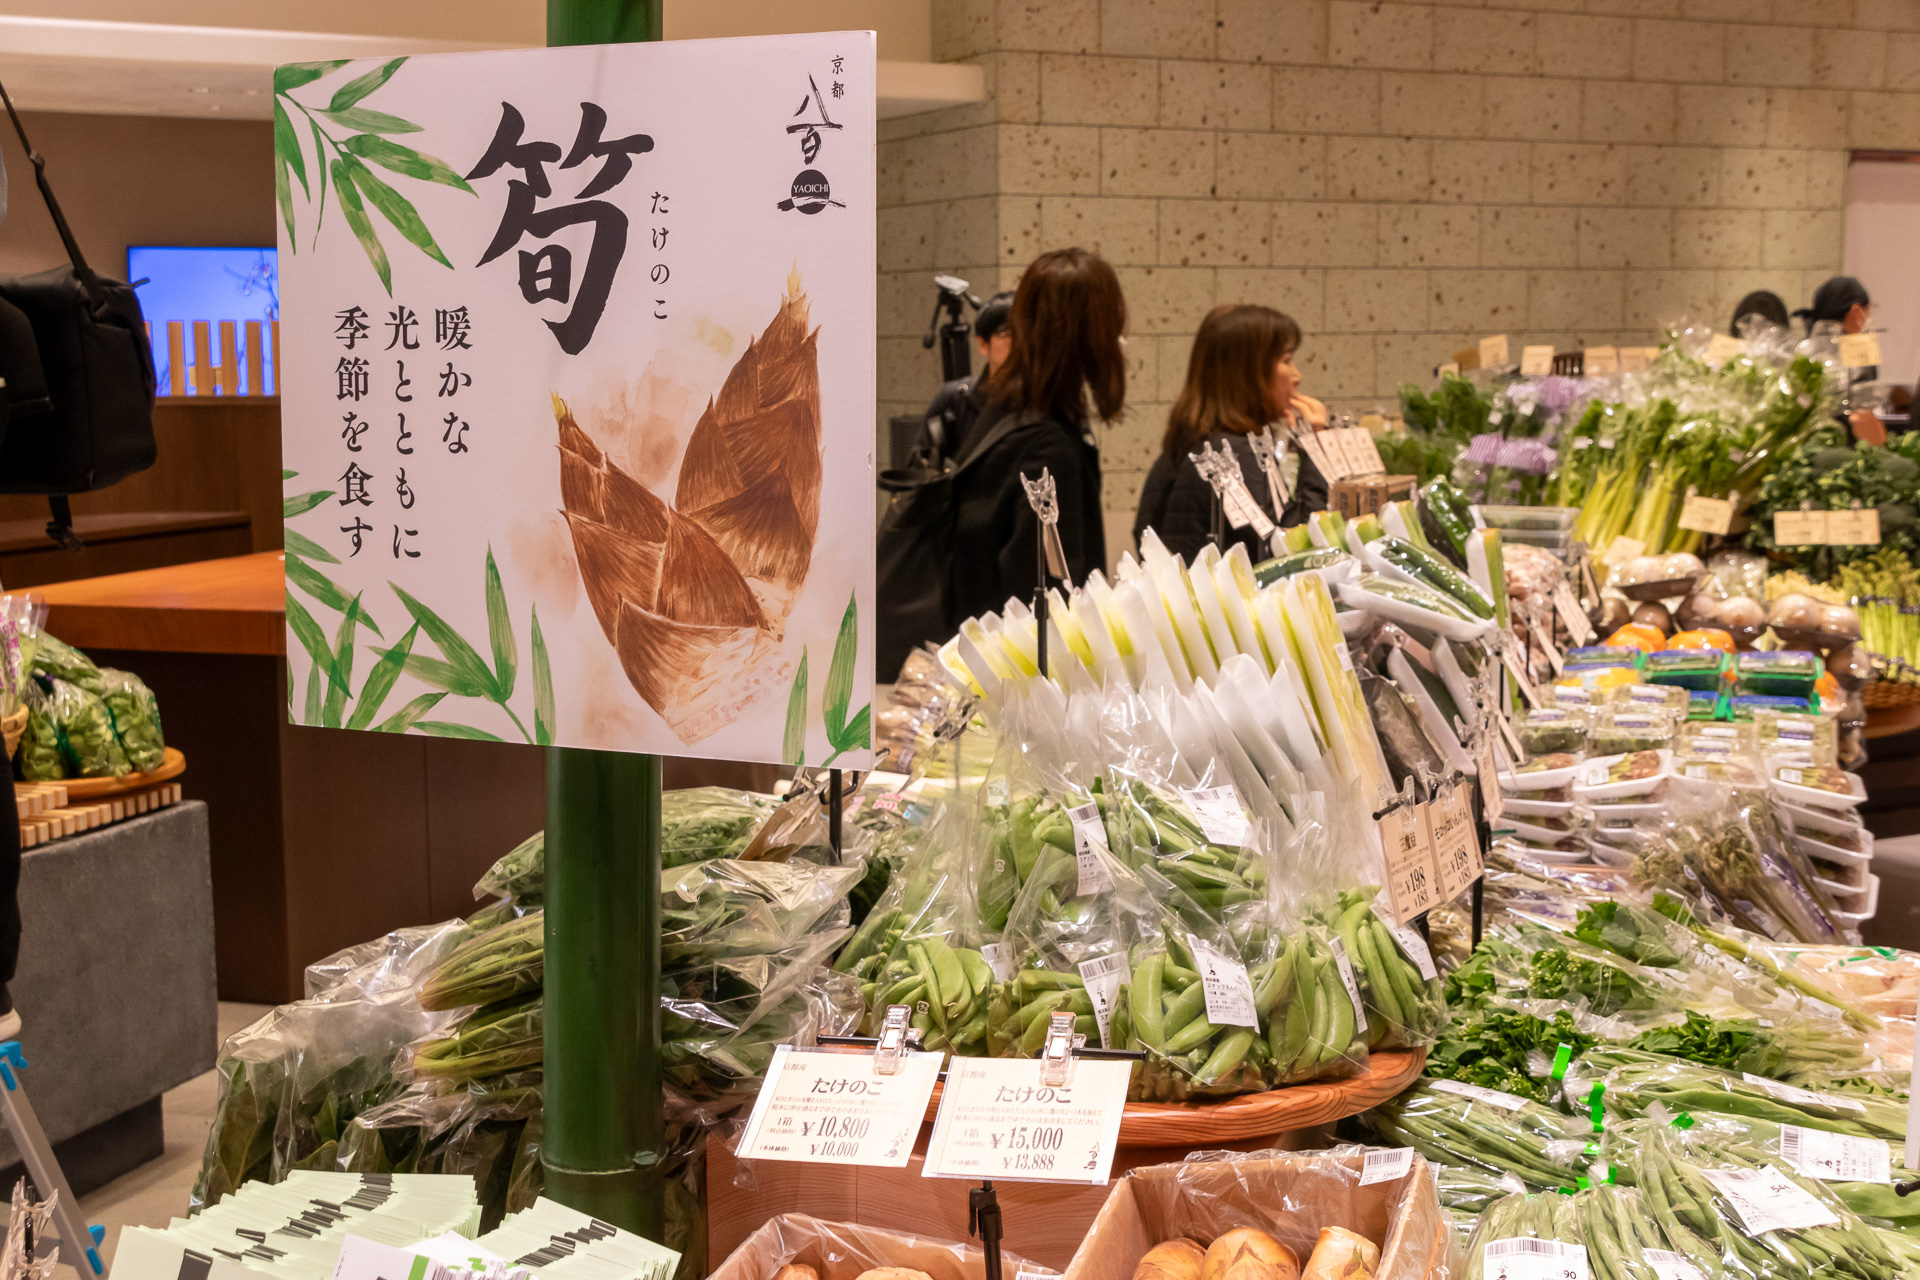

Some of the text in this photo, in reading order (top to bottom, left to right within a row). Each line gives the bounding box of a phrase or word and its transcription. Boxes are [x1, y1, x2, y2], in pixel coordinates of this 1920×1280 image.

[831, 55, 844, 99] 京都
[793, 184, 828, 193] YAOICHI
[465, 102, 655, 355] 筍
[651, 191, 669, 320] たけのこ
[435, 305, 472, 454] 暖かな
[334, 305, 374, 558] 季節を食す
[384, 304, 421, 559] 光とともに
[811, 1077, 884, 1095] たけのこ
[995, 1085, 1072, 1104] たけのこ
[809, 1141, 859, 1157] ¥10,000
[1003, 1153, 1055, 1170] ¥13,888
